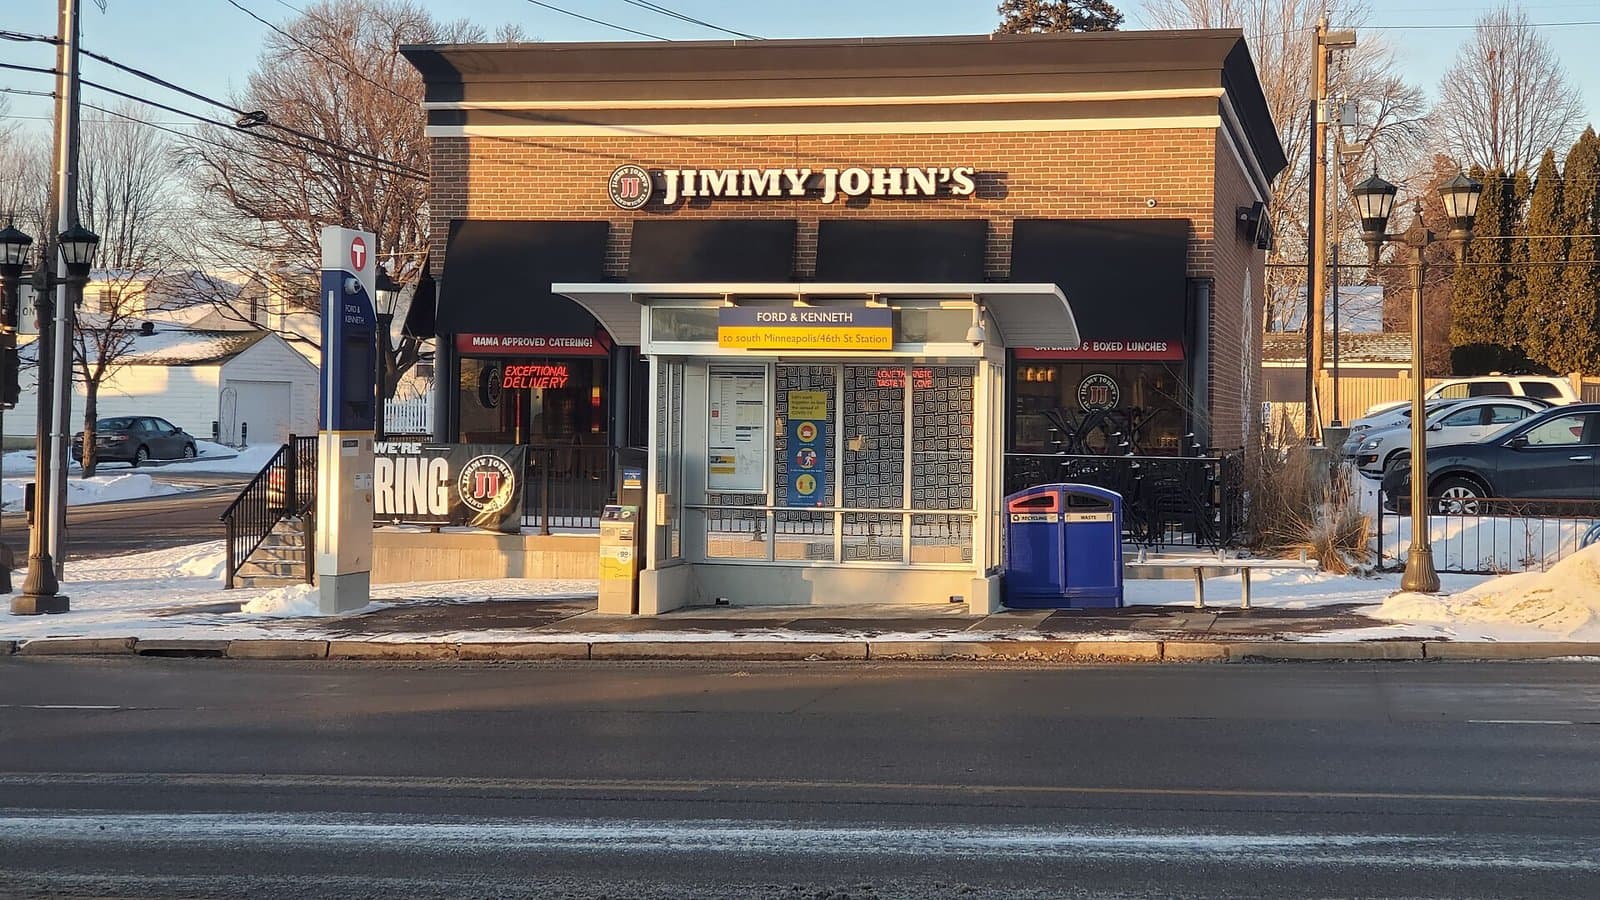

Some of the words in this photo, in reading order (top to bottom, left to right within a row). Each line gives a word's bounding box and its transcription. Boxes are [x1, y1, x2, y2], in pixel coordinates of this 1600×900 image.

[621, 177, 640, 198] JJ
[664, 169, 811, 204] JIMMY
[821, 167, 975, 204] JOHN'S
[352, 244, 365, 267] T
[757, 312, 787, 322] FORD
[790, 312, 798, 322] &
[800, 312, 853, 322] KENNETH
[472, 337, 499, 346] MAMA
[502, 337, 545, 347] APPROVED
[549, 338, 592, 347] CATERING!
[723, 334, 733, 342] to
[736, 333, 760, 342] south
[765, 333, 840, 344] Minneapolis/46th
[844, 334, 853, 343] St
[856, 334, 888, 344] Station
[1082, 342, 1090, 351] &
[1093, 342, 1123, 351] BOXED
[1127, 342, 1167, 352] LUNCHES
[505, 366, 569, 377] EXCEPTIONAL
[503, 377, 568, 389] DELIVERY
[374, 442, 421, 454] WE'RE
[463, 459, 486, 484] JIMMY
[374, 457, 449, 515] RING
[474, 471, 500, 498] JJ
